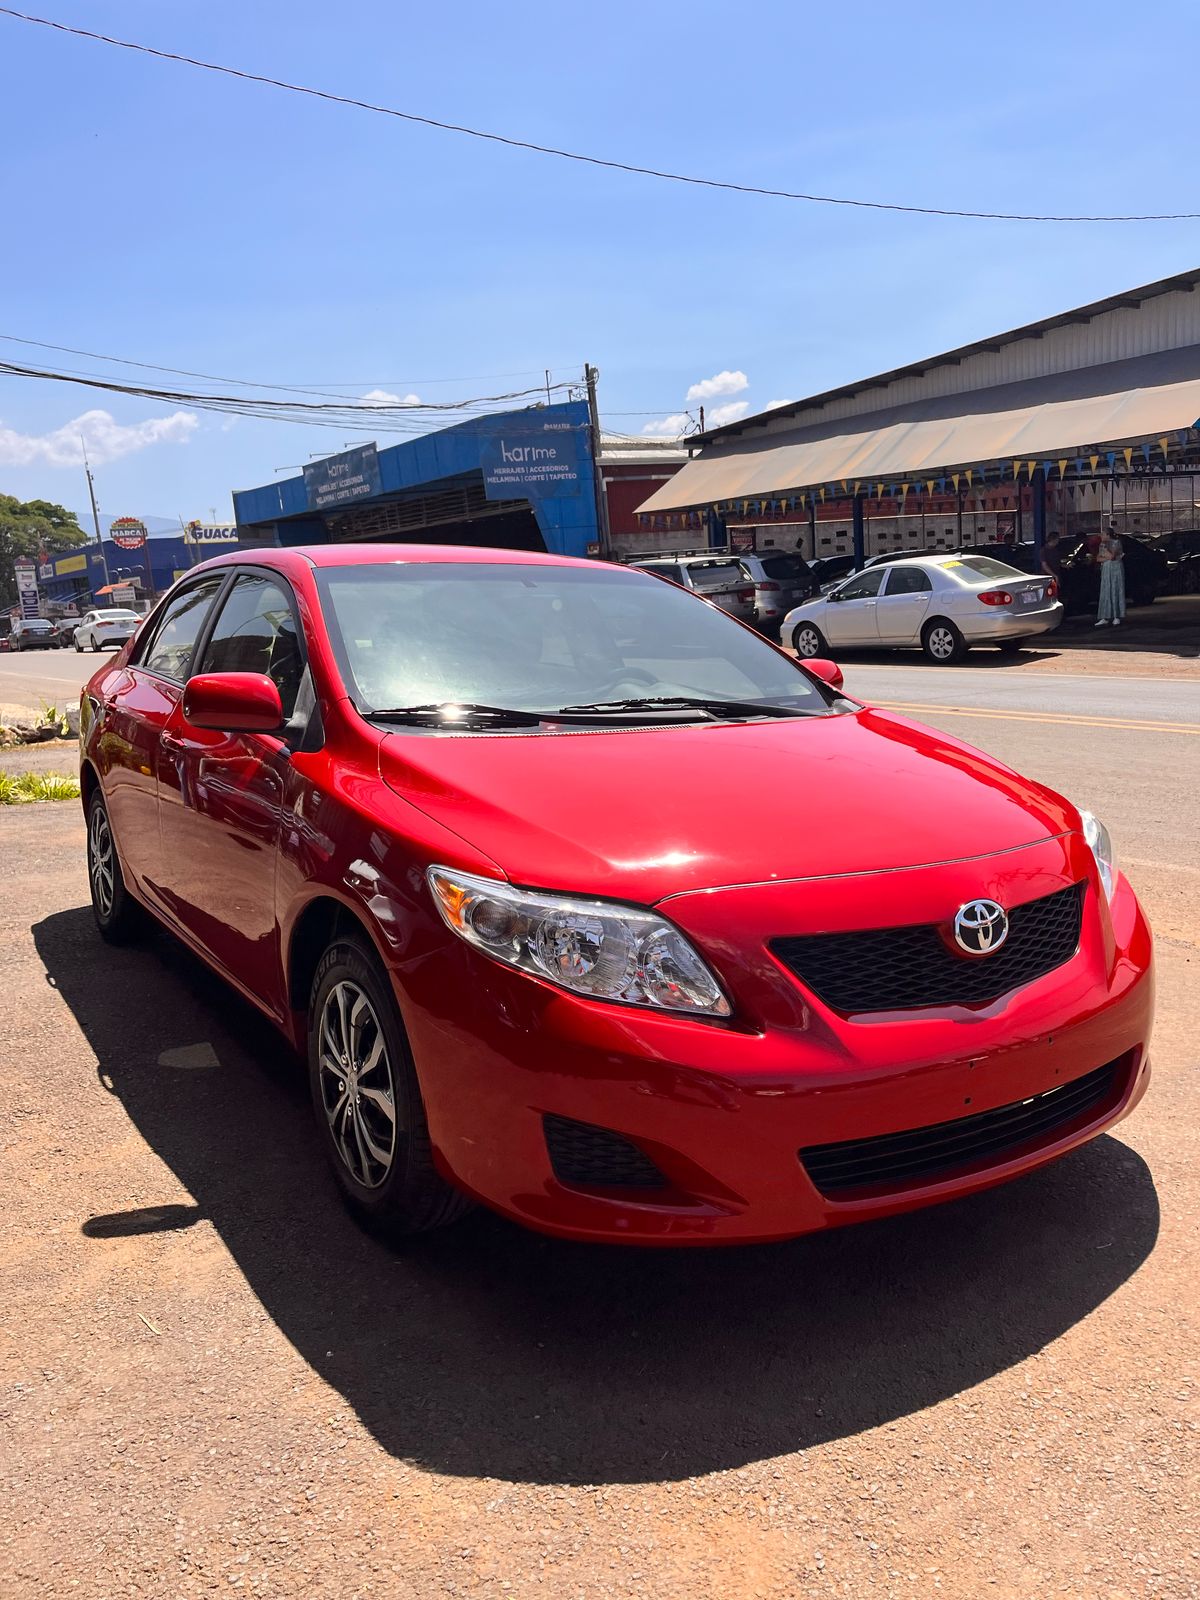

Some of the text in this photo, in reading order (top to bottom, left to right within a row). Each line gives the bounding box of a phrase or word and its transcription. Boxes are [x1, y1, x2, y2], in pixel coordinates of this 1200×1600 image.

[501, 440, 557, 462] karime
[494, 465, 569, 475] HERRAJES ACCESORIOS
[487, 472, 577, 483] MELAMINA CORTE TAPETEO
